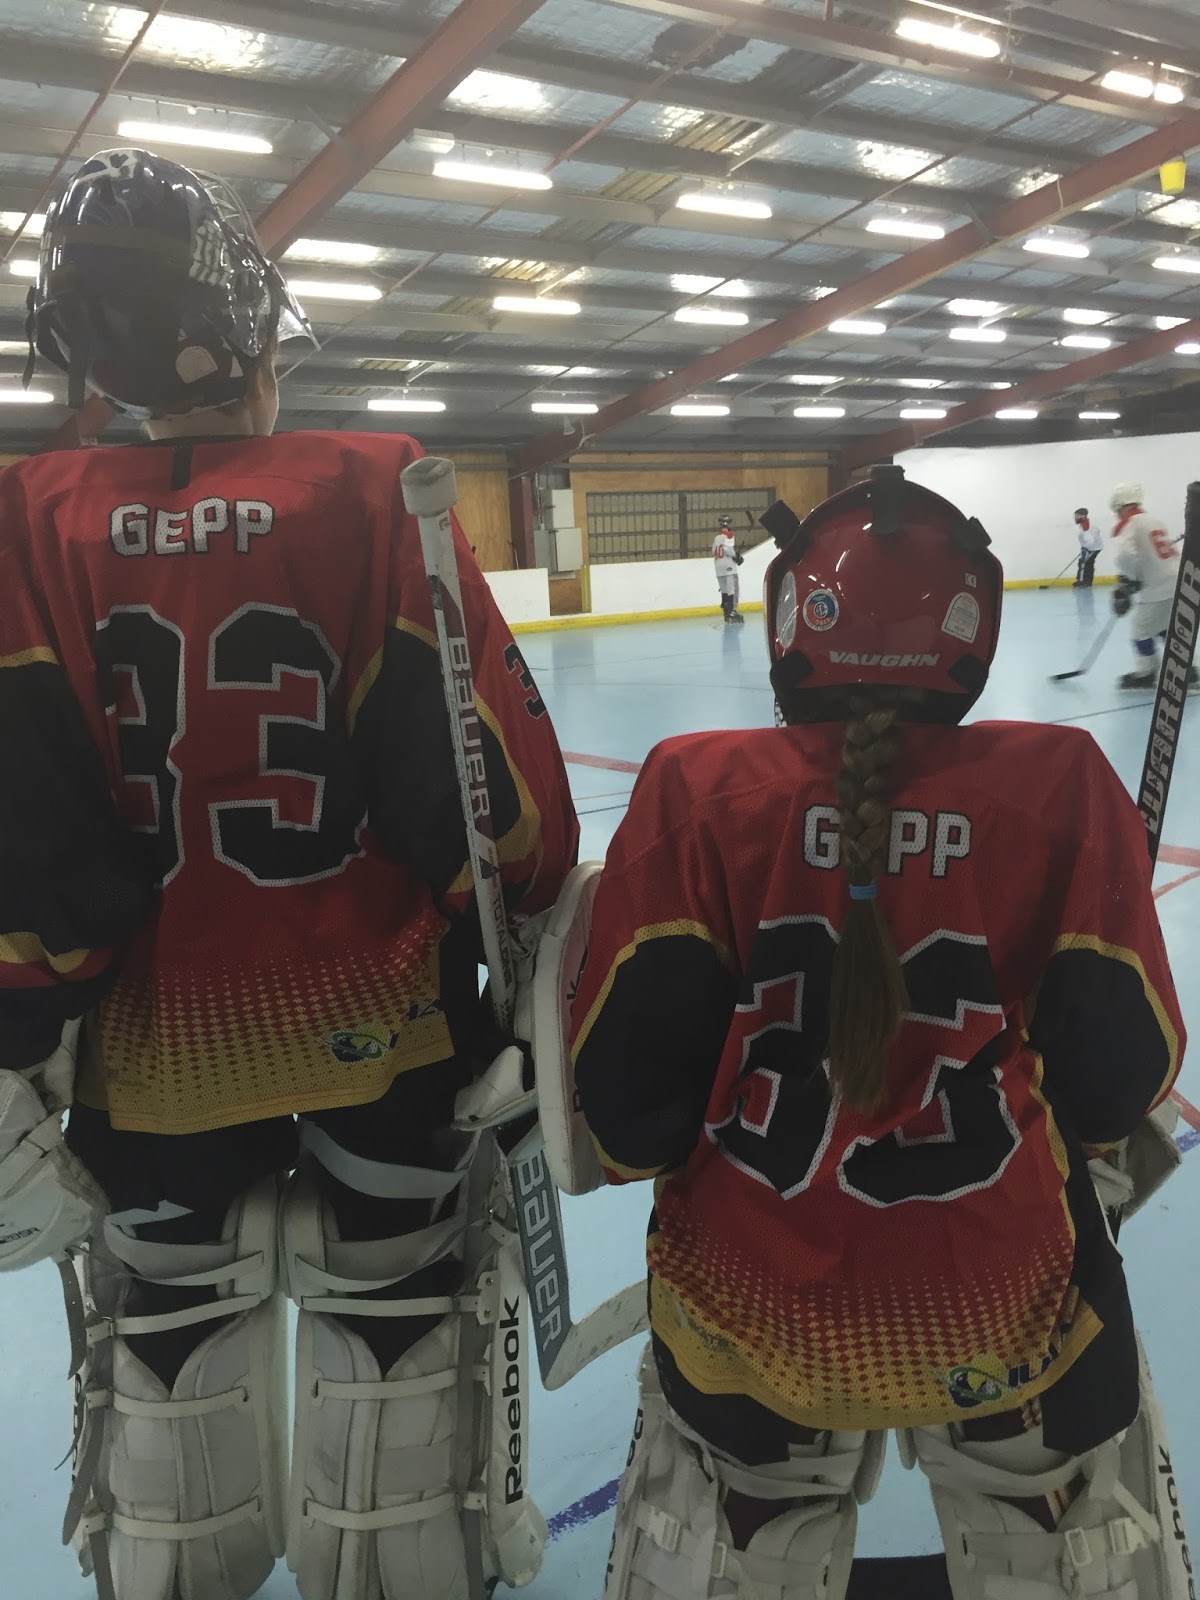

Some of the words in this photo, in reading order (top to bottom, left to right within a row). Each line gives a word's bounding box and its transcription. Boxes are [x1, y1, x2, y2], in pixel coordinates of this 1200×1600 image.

[110, 497, 275, 556] GEPP
[448, 637, 491, 820] BAUER
[829, 650, 940, 667] VAUGHN
[1140, 559, 1200, 835] WARRIOR
[804, 805, 971, 877] GPP
[515, 1155, 563, 1353] BAUER
[499, 1294, 524, 1504] Reebok
[1158, 1444, 1197, 1600] eebok
